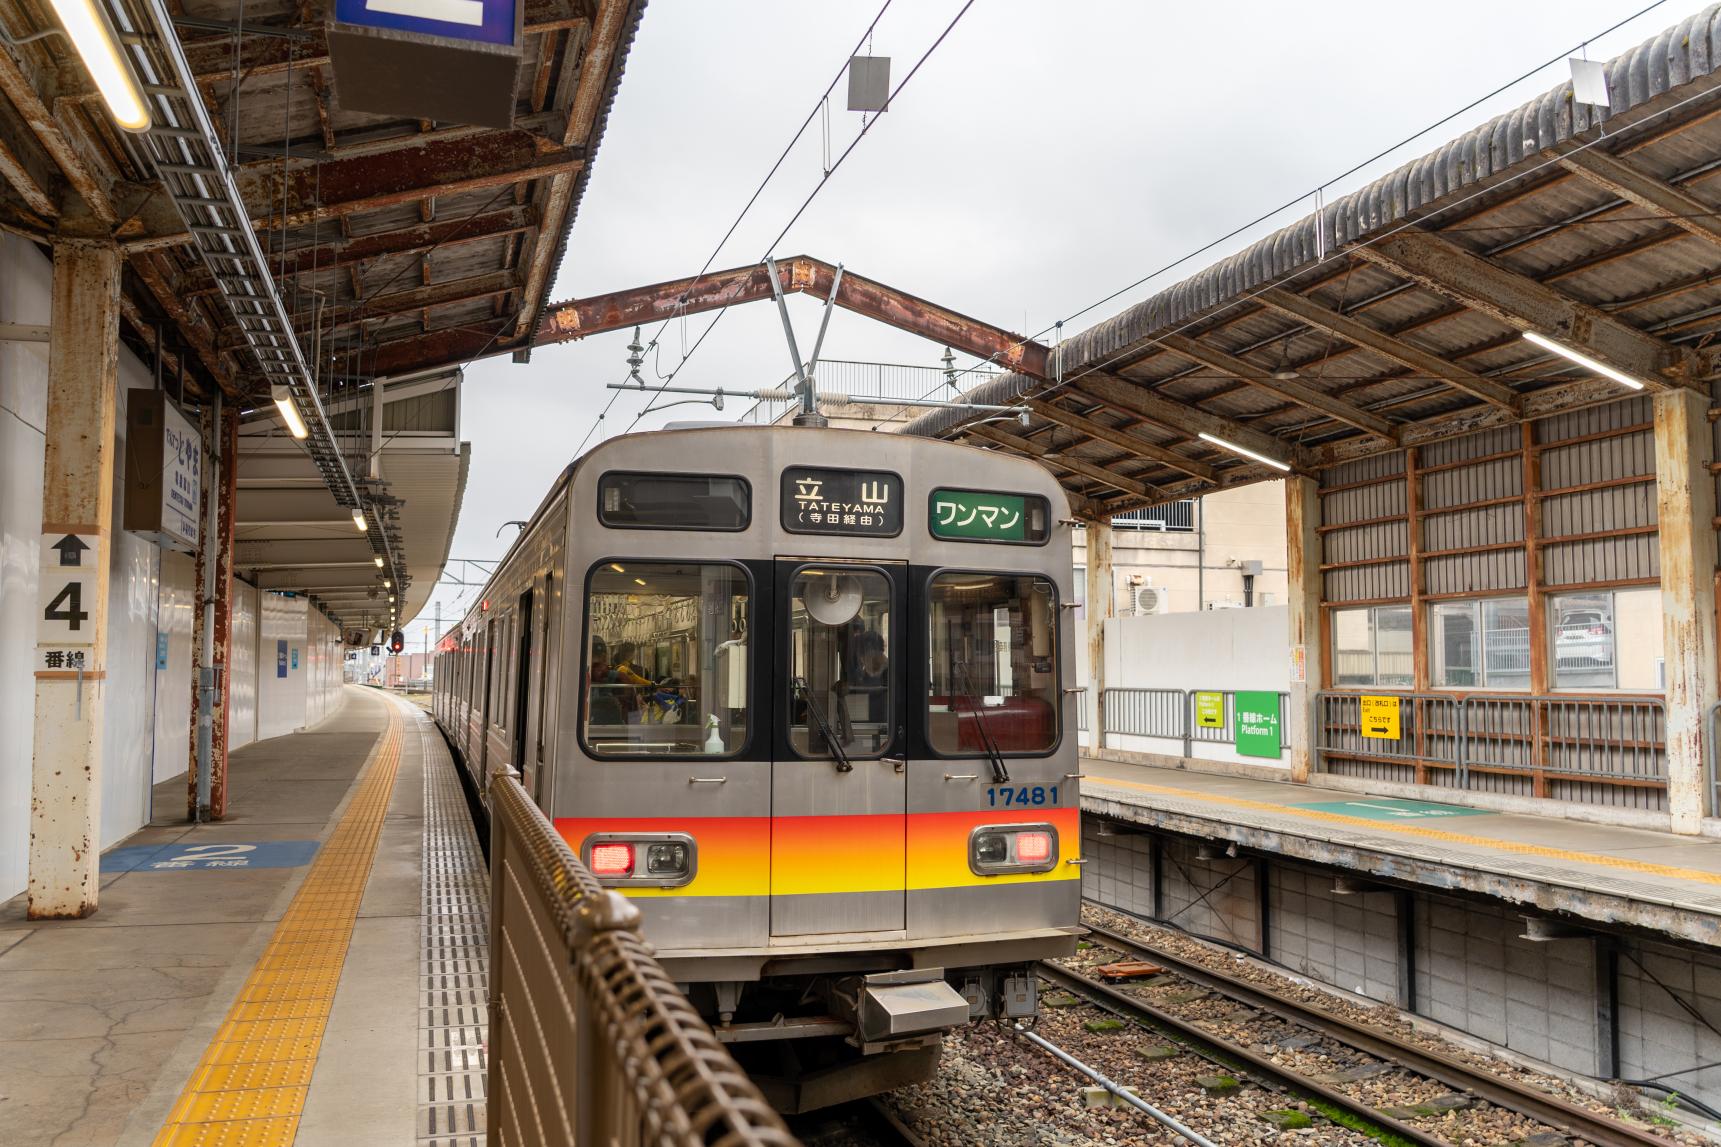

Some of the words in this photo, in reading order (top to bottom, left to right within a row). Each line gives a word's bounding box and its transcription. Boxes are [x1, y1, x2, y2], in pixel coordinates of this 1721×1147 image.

[799, 501, 884, 514] TATEYAMA
[936, 501, 1020, 529] ワンマン
[45, 582, 88, 631] 4
[45, 651, 85, 668] 番線
[1241, 724, 1269, 736] Platform
[1269, 726, 1274, 736] 1
[987, 786, 1057, 806] 17481
[170, 844, 257, 861] 2
